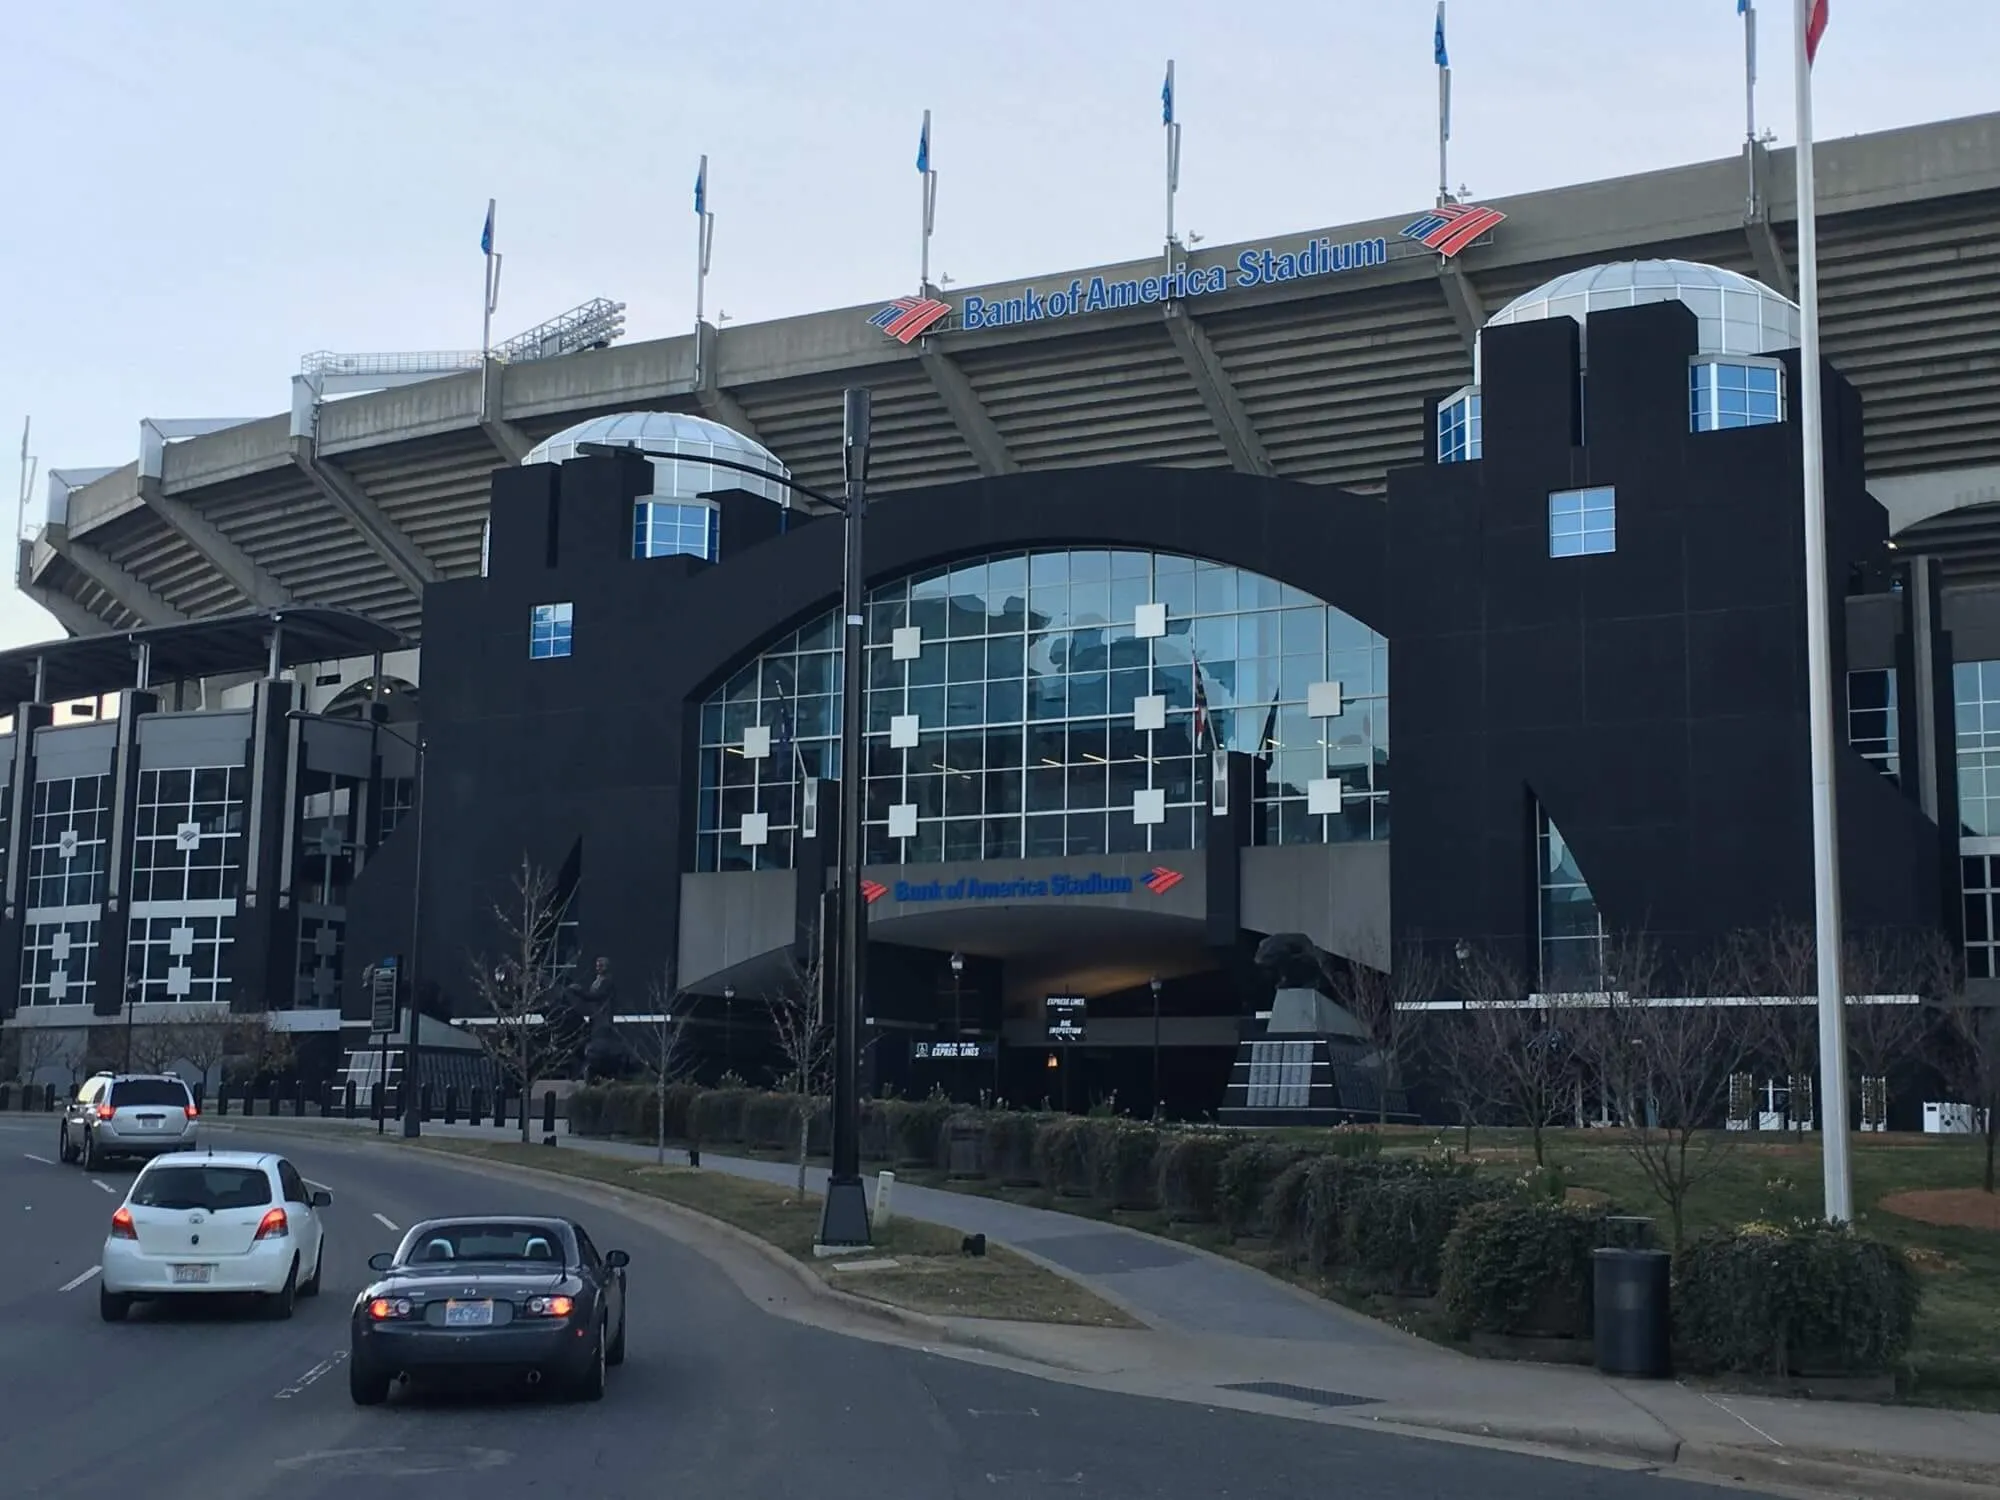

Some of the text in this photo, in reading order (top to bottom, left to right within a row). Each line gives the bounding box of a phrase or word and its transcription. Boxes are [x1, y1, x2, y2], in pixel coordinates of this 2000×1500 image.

[963, 237, 1387, 330] Bank of America Stadium
[895, 872, 1133, 901] Bank of America Stadium
